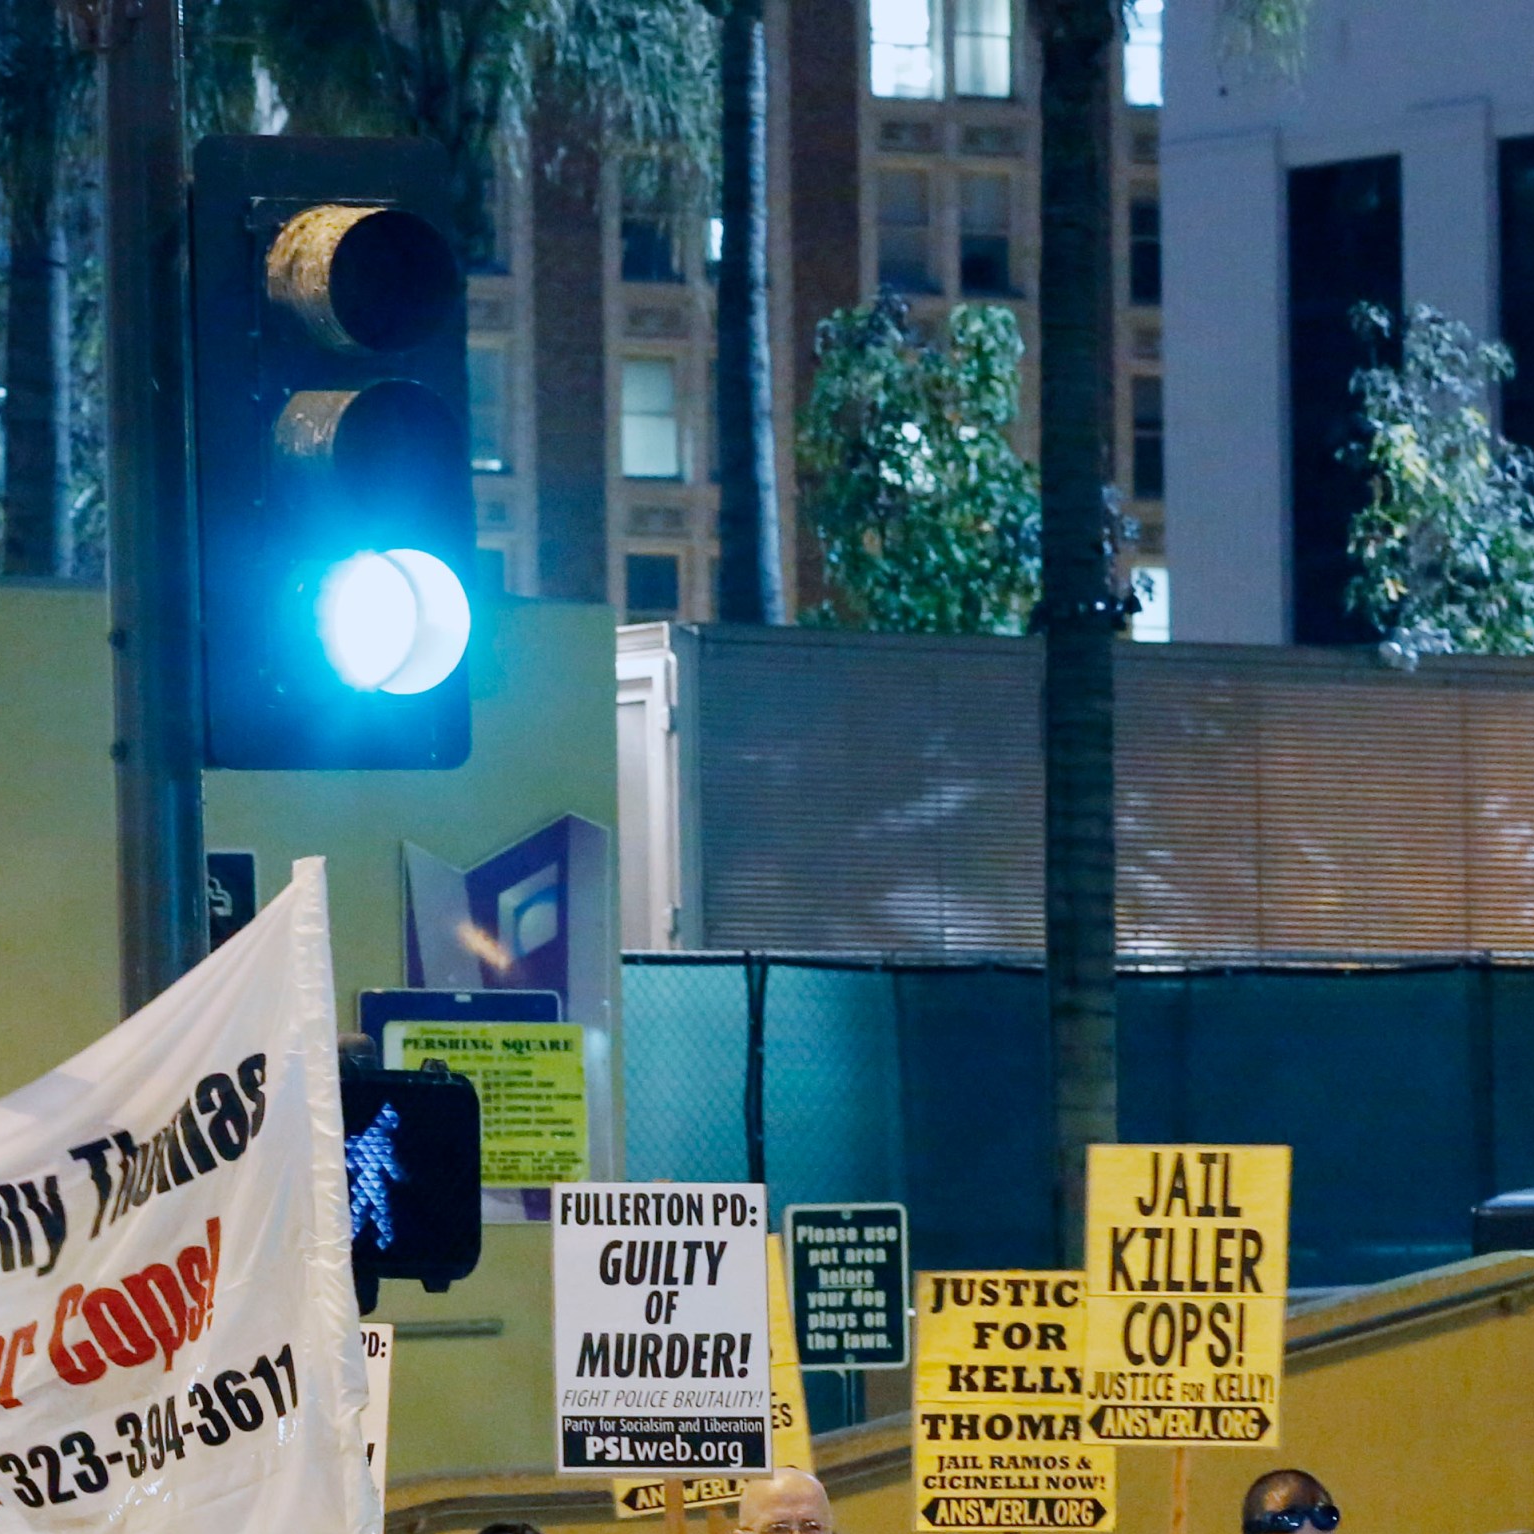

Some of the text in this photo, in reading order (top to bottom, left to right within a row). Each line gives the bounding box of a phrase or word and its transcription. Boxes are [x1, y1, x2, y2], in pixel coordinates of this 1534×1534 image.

[402, 1037, 573, 1054] PERSHING SQUARE
[1136, 1152, 1241, 1218] JAIL
[560, 1192, 758, 1228] FULLERTON PD:
[796, 1225, 898, 1244] Please use
[599, 1240, 727, 1287] GUILTY
[808, 1248, 887, 1267] pet area
[1110, 1227, 1265, 1293] KILLER
[818, 1268, 875, 1286] before
[46, 1216, 221, 1386] Cops!
[644, 1290, 679, 1326] OF
[807, 1290, 886, 1309] your dog
[930, 1277, 1086, 1314] JUSTIC
[808, 1311, 887, 1331] plays on
[1123, 1301, 1246, 1368] COPS!
[806, 1332, 838, 1350] the
[972, 1322, 1067, 1351] FOR
[575, 1332, 752, 1379] MURDER!
[947, 1365, 1082, 1395] KELLY
[1087, 1372, 1275, 1404] JUSTICE FOR KELLY!
[562, 1389, 763, 1409] FIGHT POLICE BRUTALITY!
[564, 1418, 596, 1435] Party
[599, 1417, 616, 1432] for
[679, 1418, 700, 1433] and
[704, 1418, 763, 1433] Liberation
[921, 1414, 1082, 1442] THOMA
[1101, 1408, 1262, 1440] ANSWERLA.ORG
[585, 1434, 744, 1468] PSLweb.org
[937, 1455, 1092, 1472] JAIL RAMOS &
[923, 1475, 1106, 1491] CICINELLI NOW!
[934, 1498, 1096, 1527] ANSWERLA.ORG
